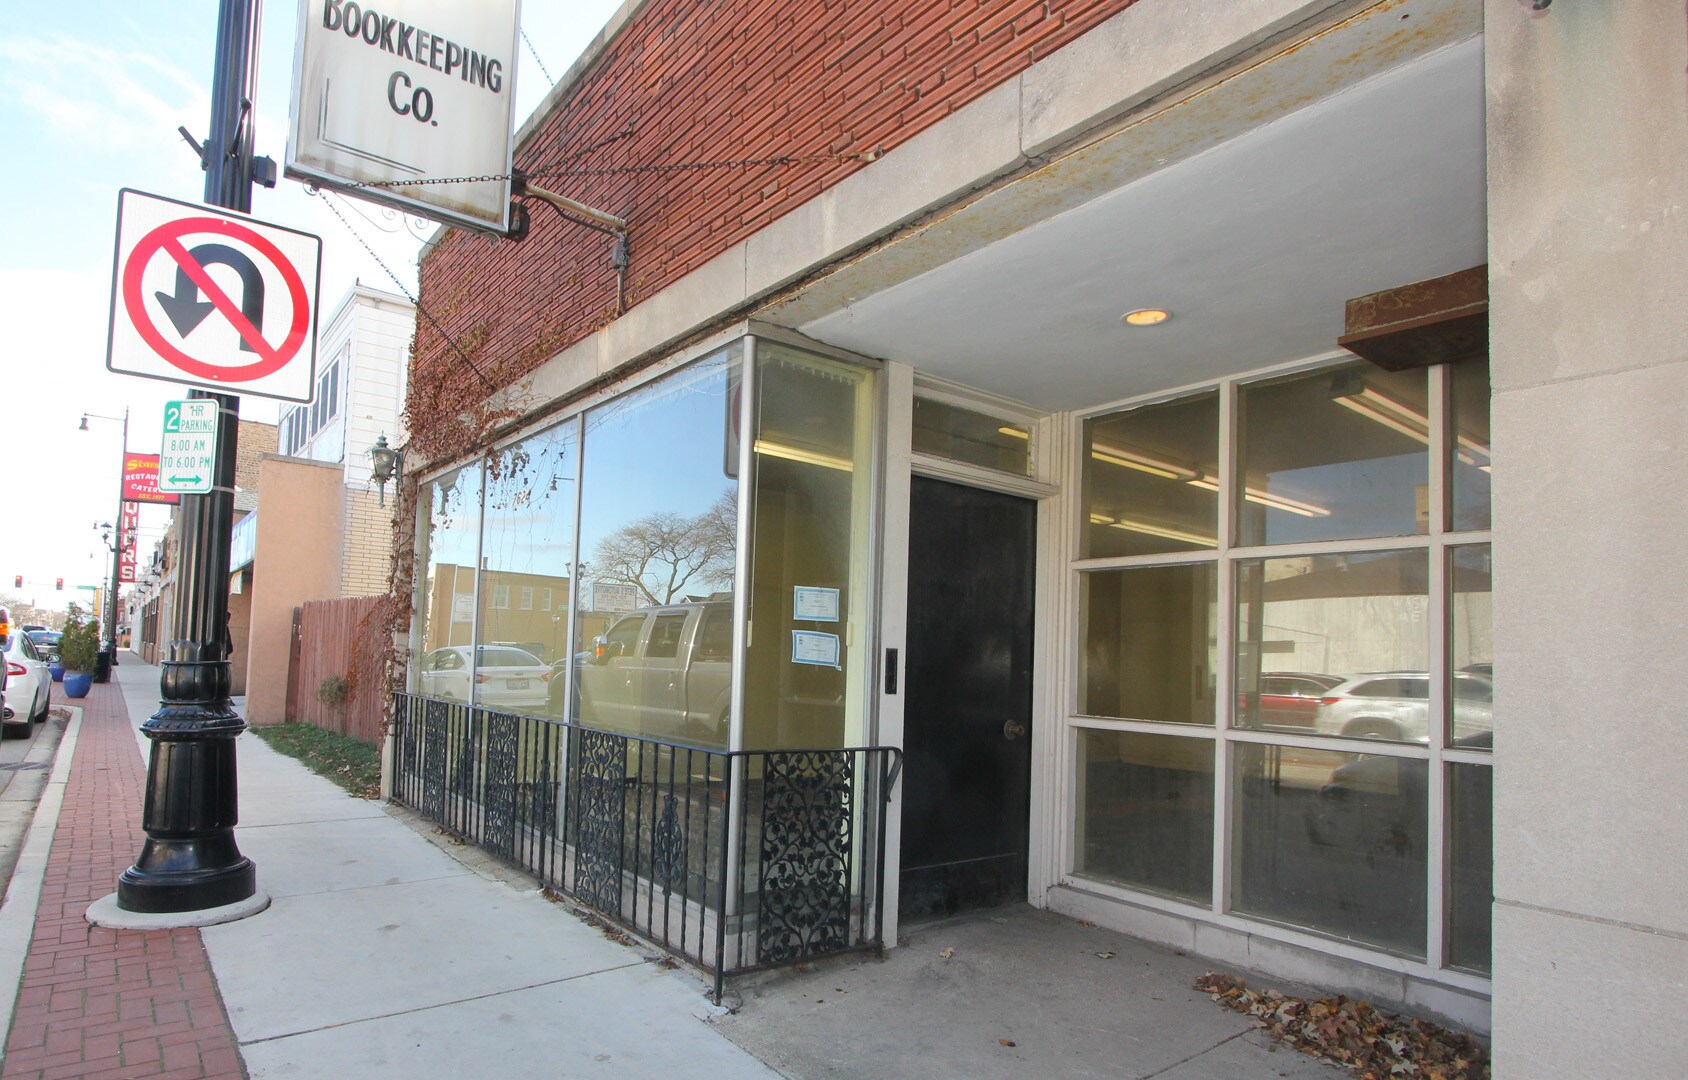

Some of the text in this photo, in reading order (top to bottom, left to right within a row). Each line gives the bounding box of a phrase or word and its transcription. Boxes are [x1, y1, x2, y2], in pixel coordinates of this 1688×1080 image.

[322, 0, 503, 93] BOOKKEEPING
[191, 405, 204, 416] HR
[166, 407, 179, 430] 2
[180, 419, 213, 431] PARKING
[193, 440, 205, 451] AM
[164, 456, 173, 468] TO
[199, 456, 211, 468] PM
[125, 473, 159, 481] RESTAU
[130, 483, 162, 493] CATER
